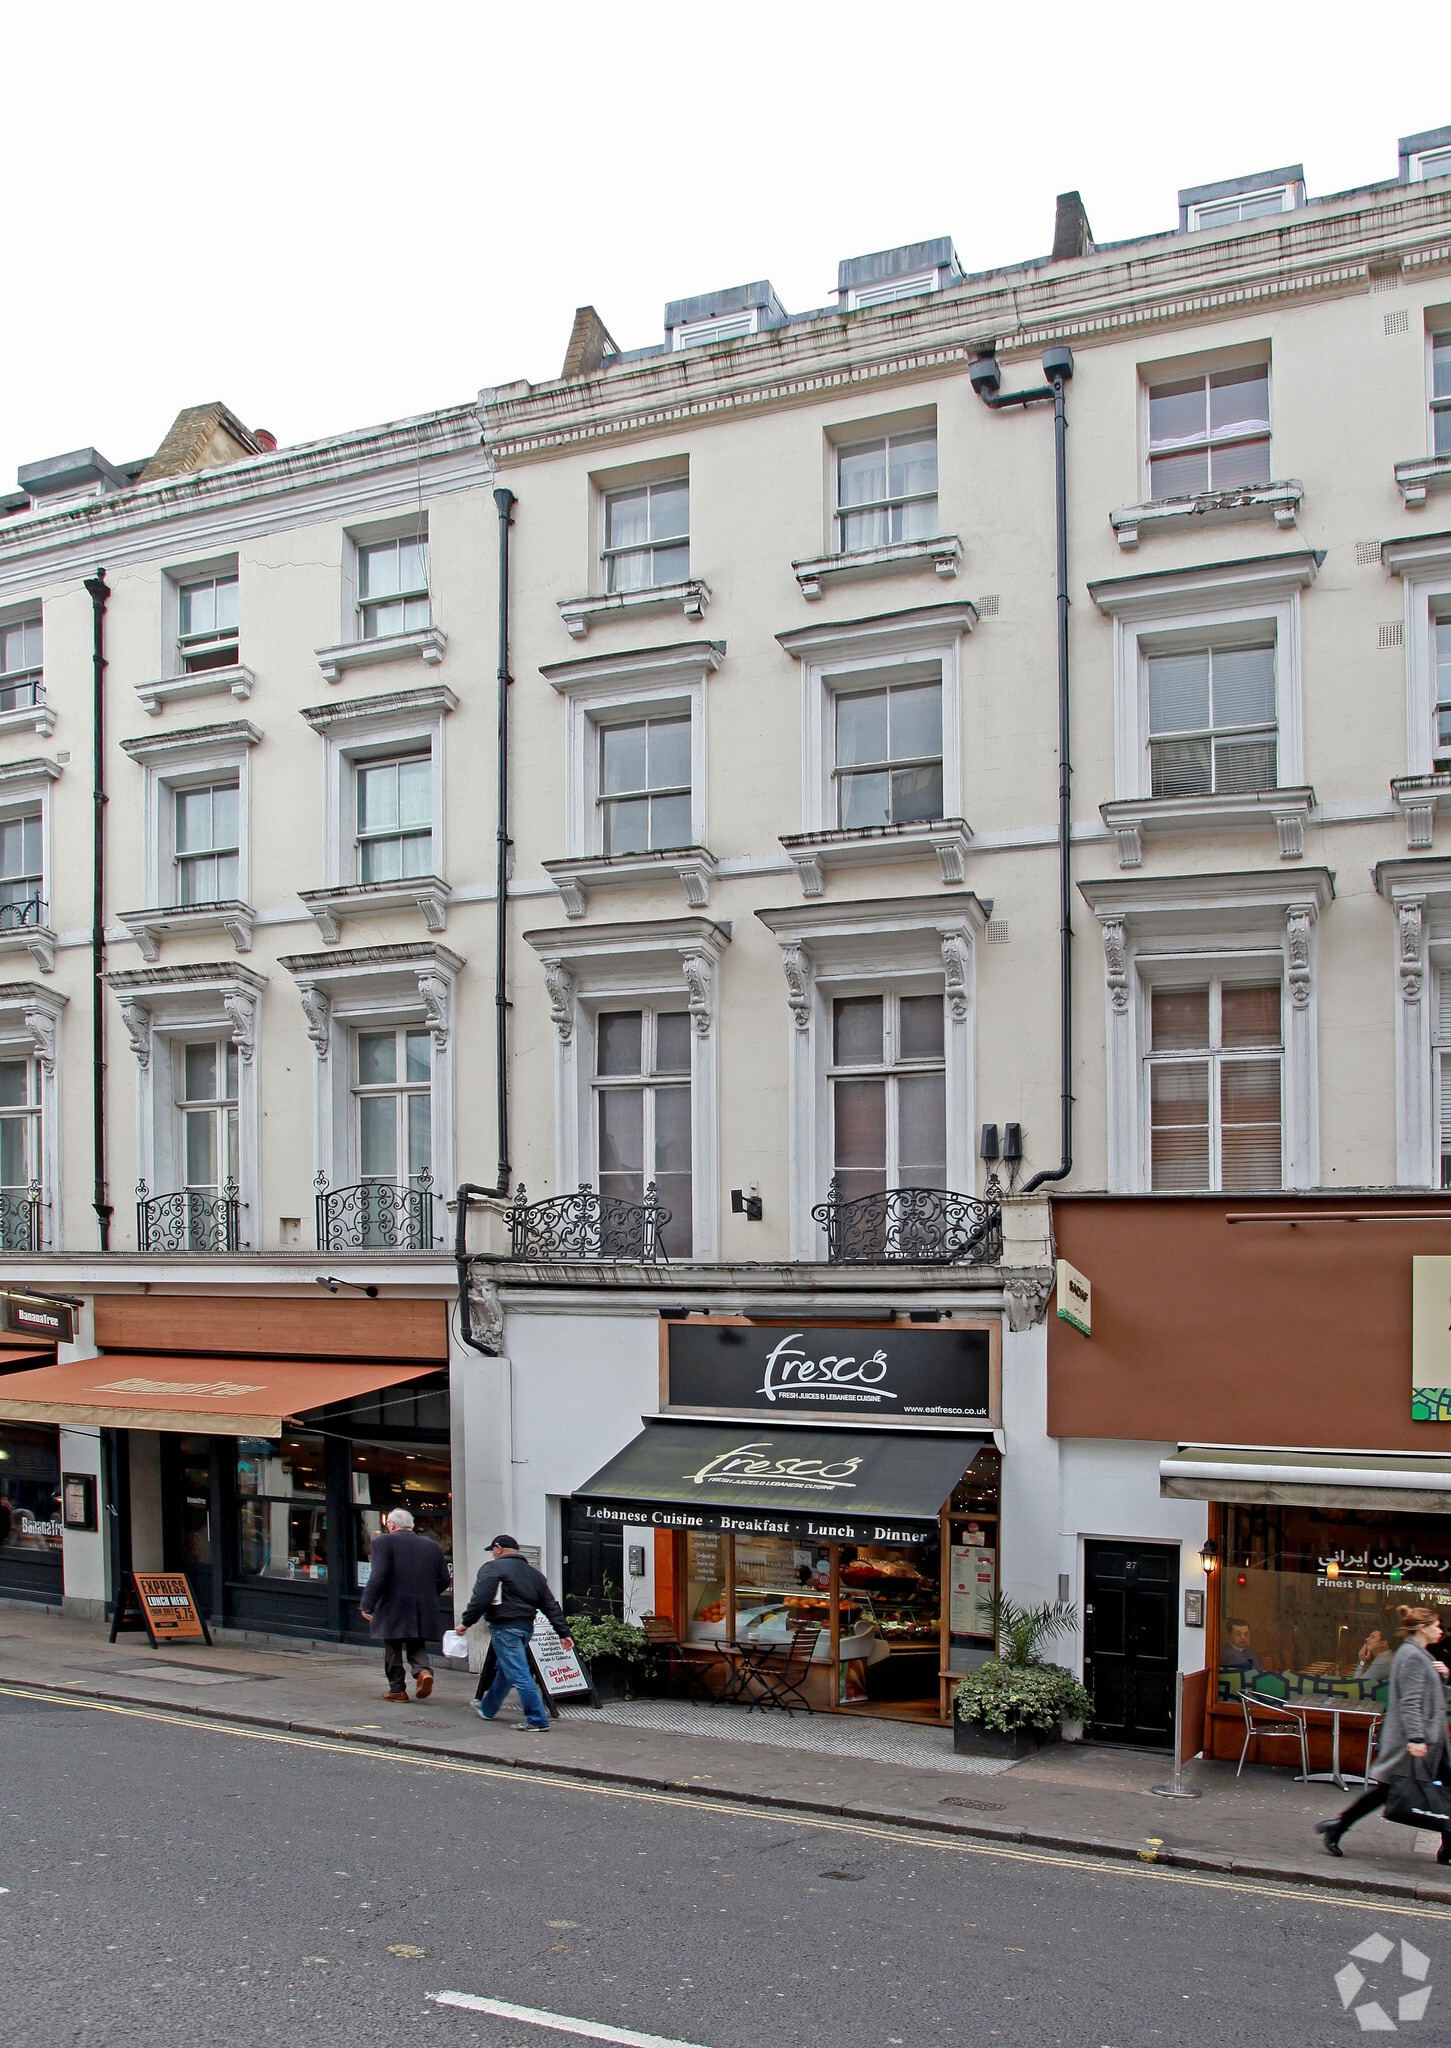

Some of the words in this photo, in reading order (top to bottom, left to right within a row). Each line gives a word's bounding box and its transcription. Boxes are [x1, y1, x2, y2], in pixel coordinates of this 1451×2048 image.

[18, 1309, 59, 1326] BananaTree
[904, 1405, 987, 1416] www.eatfresco.co.uk
[732, 1478, 759, 1486] JUICES
[766, 1480, 804, 1489] LEBANESE
[804, 1483, 835, 1491] CUISINE
[586, 1506, 647, 1522] Lebanese
[651, 1511, 703, 1526] Cuisine
[720, 1516, 790, 1533] Breakfast
[807, 1522, 855, 1538] Lunch
[874, 1527, 928, 1543] Dinner
[1125, 1561, 1138, 1569] 27
[1373, 1552, 1450, 1573] رستوران
[140, 1580, 186, 1594] EXPRESS
[1316, 1577, 1353, 1588] Finest
[1356, 1580, 1400, 1592] Persian
[1405, 1583, 1451, 1595] Cuisine
[147, 1596, 170, 1606] LUNCH
[170, 1596, 189, 1606] MENU
[174, 1607, 195, 1619] 5.75
[549, 1669, 558, 1677] Eat
[554, 1676, 564, 1684] Eat
